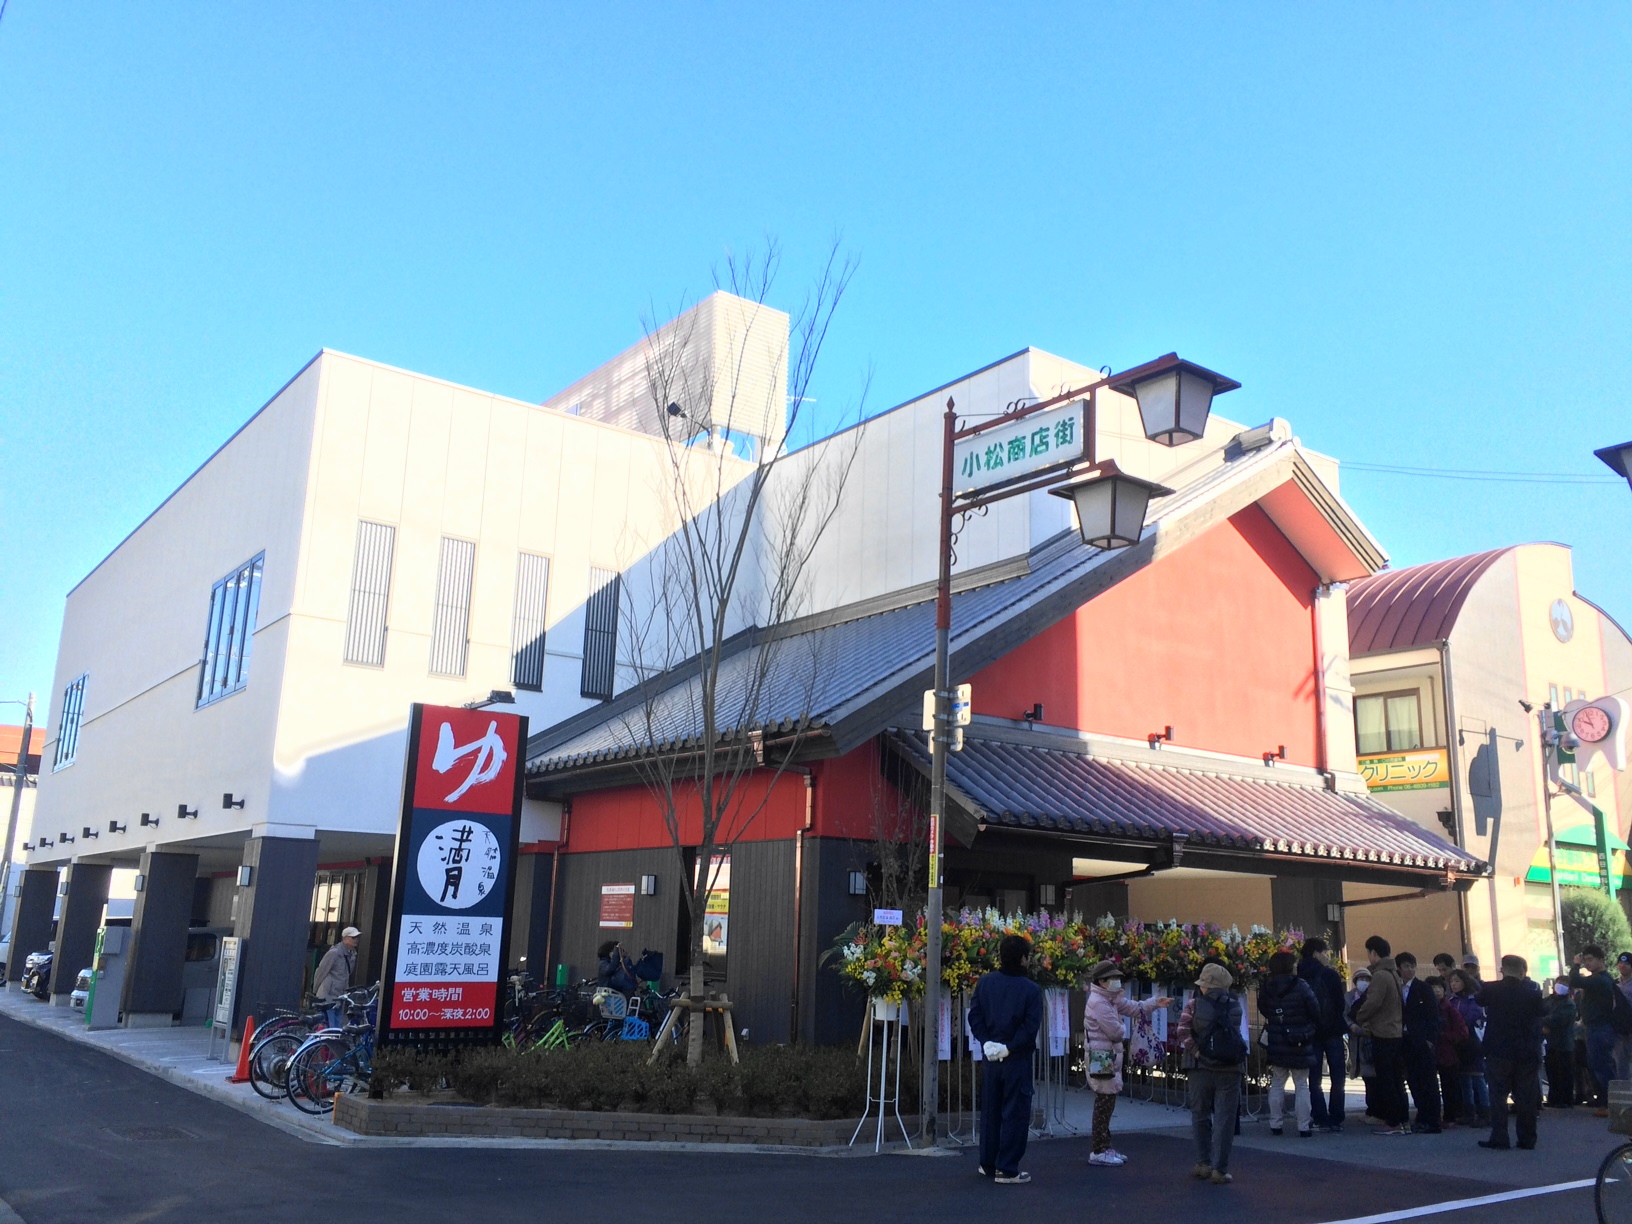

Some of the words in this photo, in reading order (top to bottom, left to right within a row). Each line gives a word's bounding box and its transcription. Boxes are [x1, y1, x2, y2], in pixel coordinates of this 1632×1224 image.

[961, 416, 1076, 478] 小松商店街
[431, 720, 508, 803] ゆ
[1360, 760, 1438, 782] クリニック
[435, 824, 474, 903] 満月
[408, 921, 494, 937] 天然温泉
[406, 941, 492, 957] 高濃度炭酸泉
[403, 962, 490, 977] 庭園露天風呂
[401, 987, 463, 1003] 営業時間
